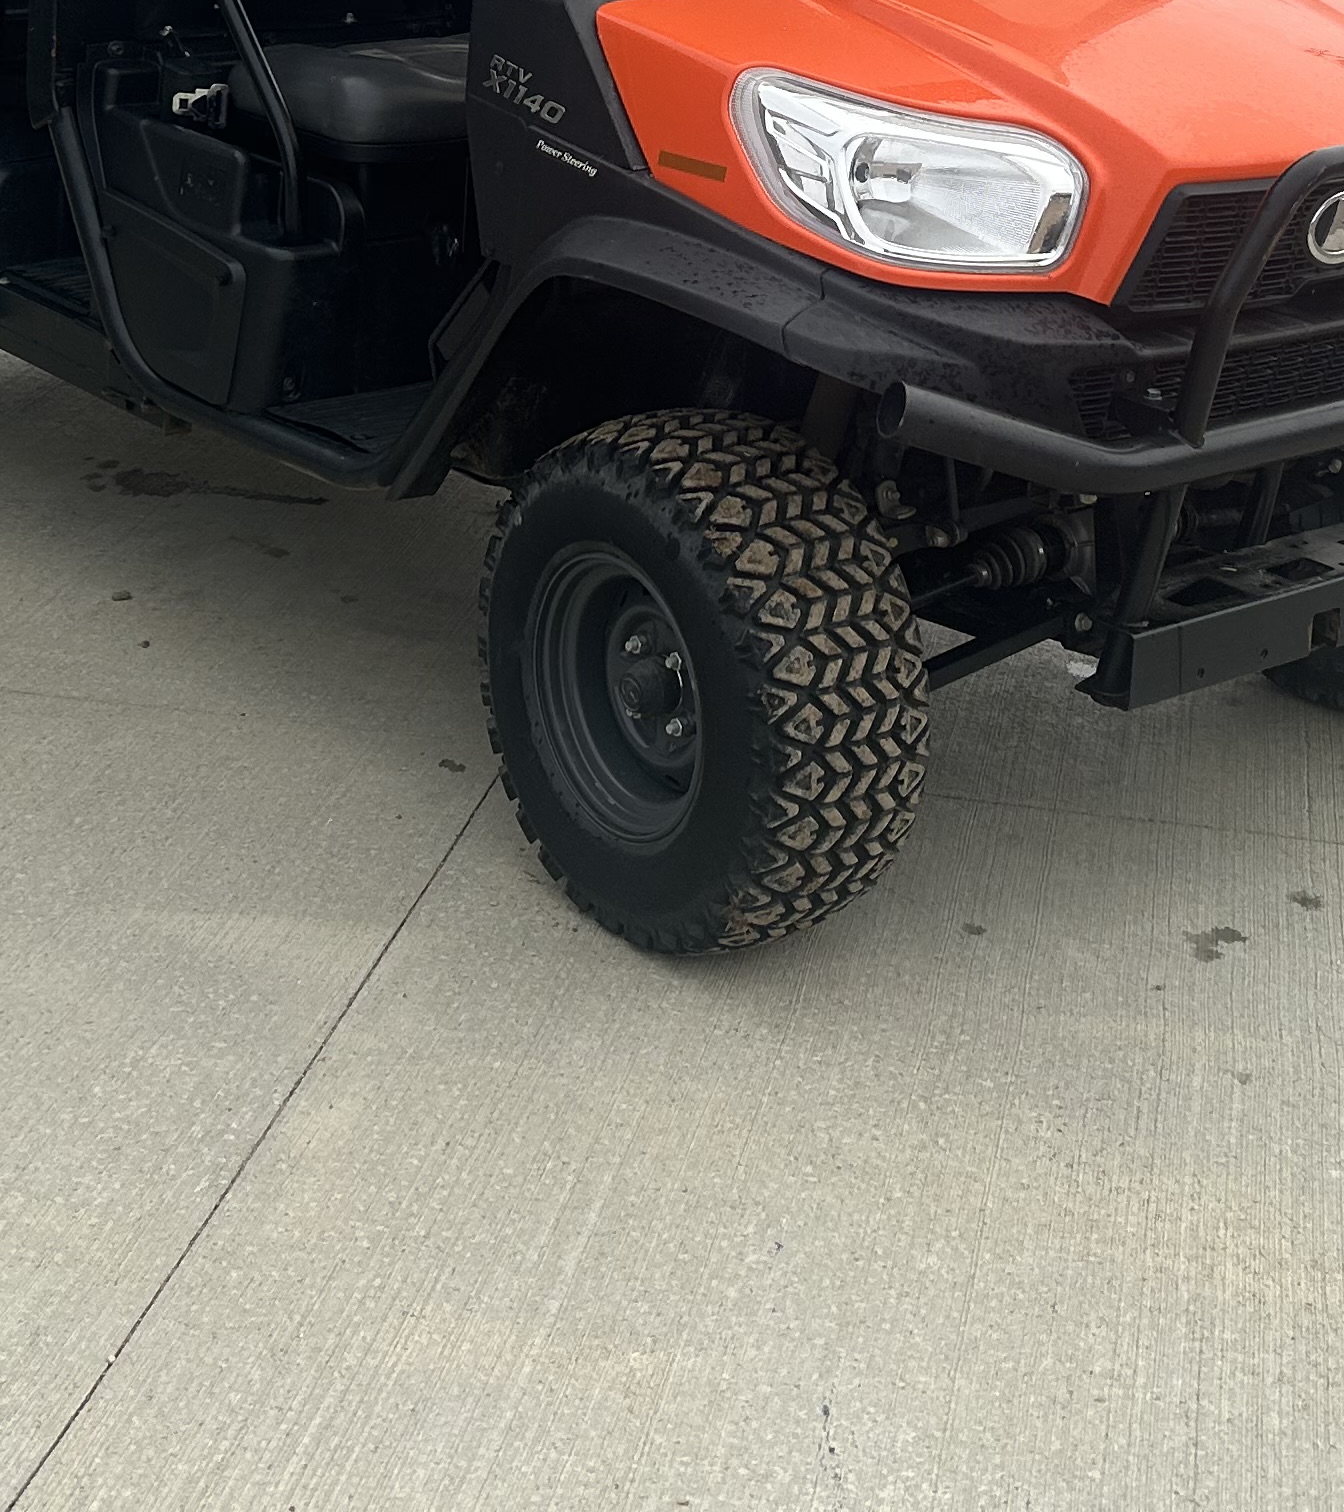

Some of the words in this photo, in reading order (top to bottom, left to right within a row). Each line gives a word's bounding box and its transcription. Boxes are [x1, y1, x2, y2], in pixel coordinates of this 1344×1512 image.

[489, 54, 534, 83] RTV
[482, 70, 567, 125] X1140
[535, 138, 563, 159] Power
[562, 151, 598, 177] Steering
